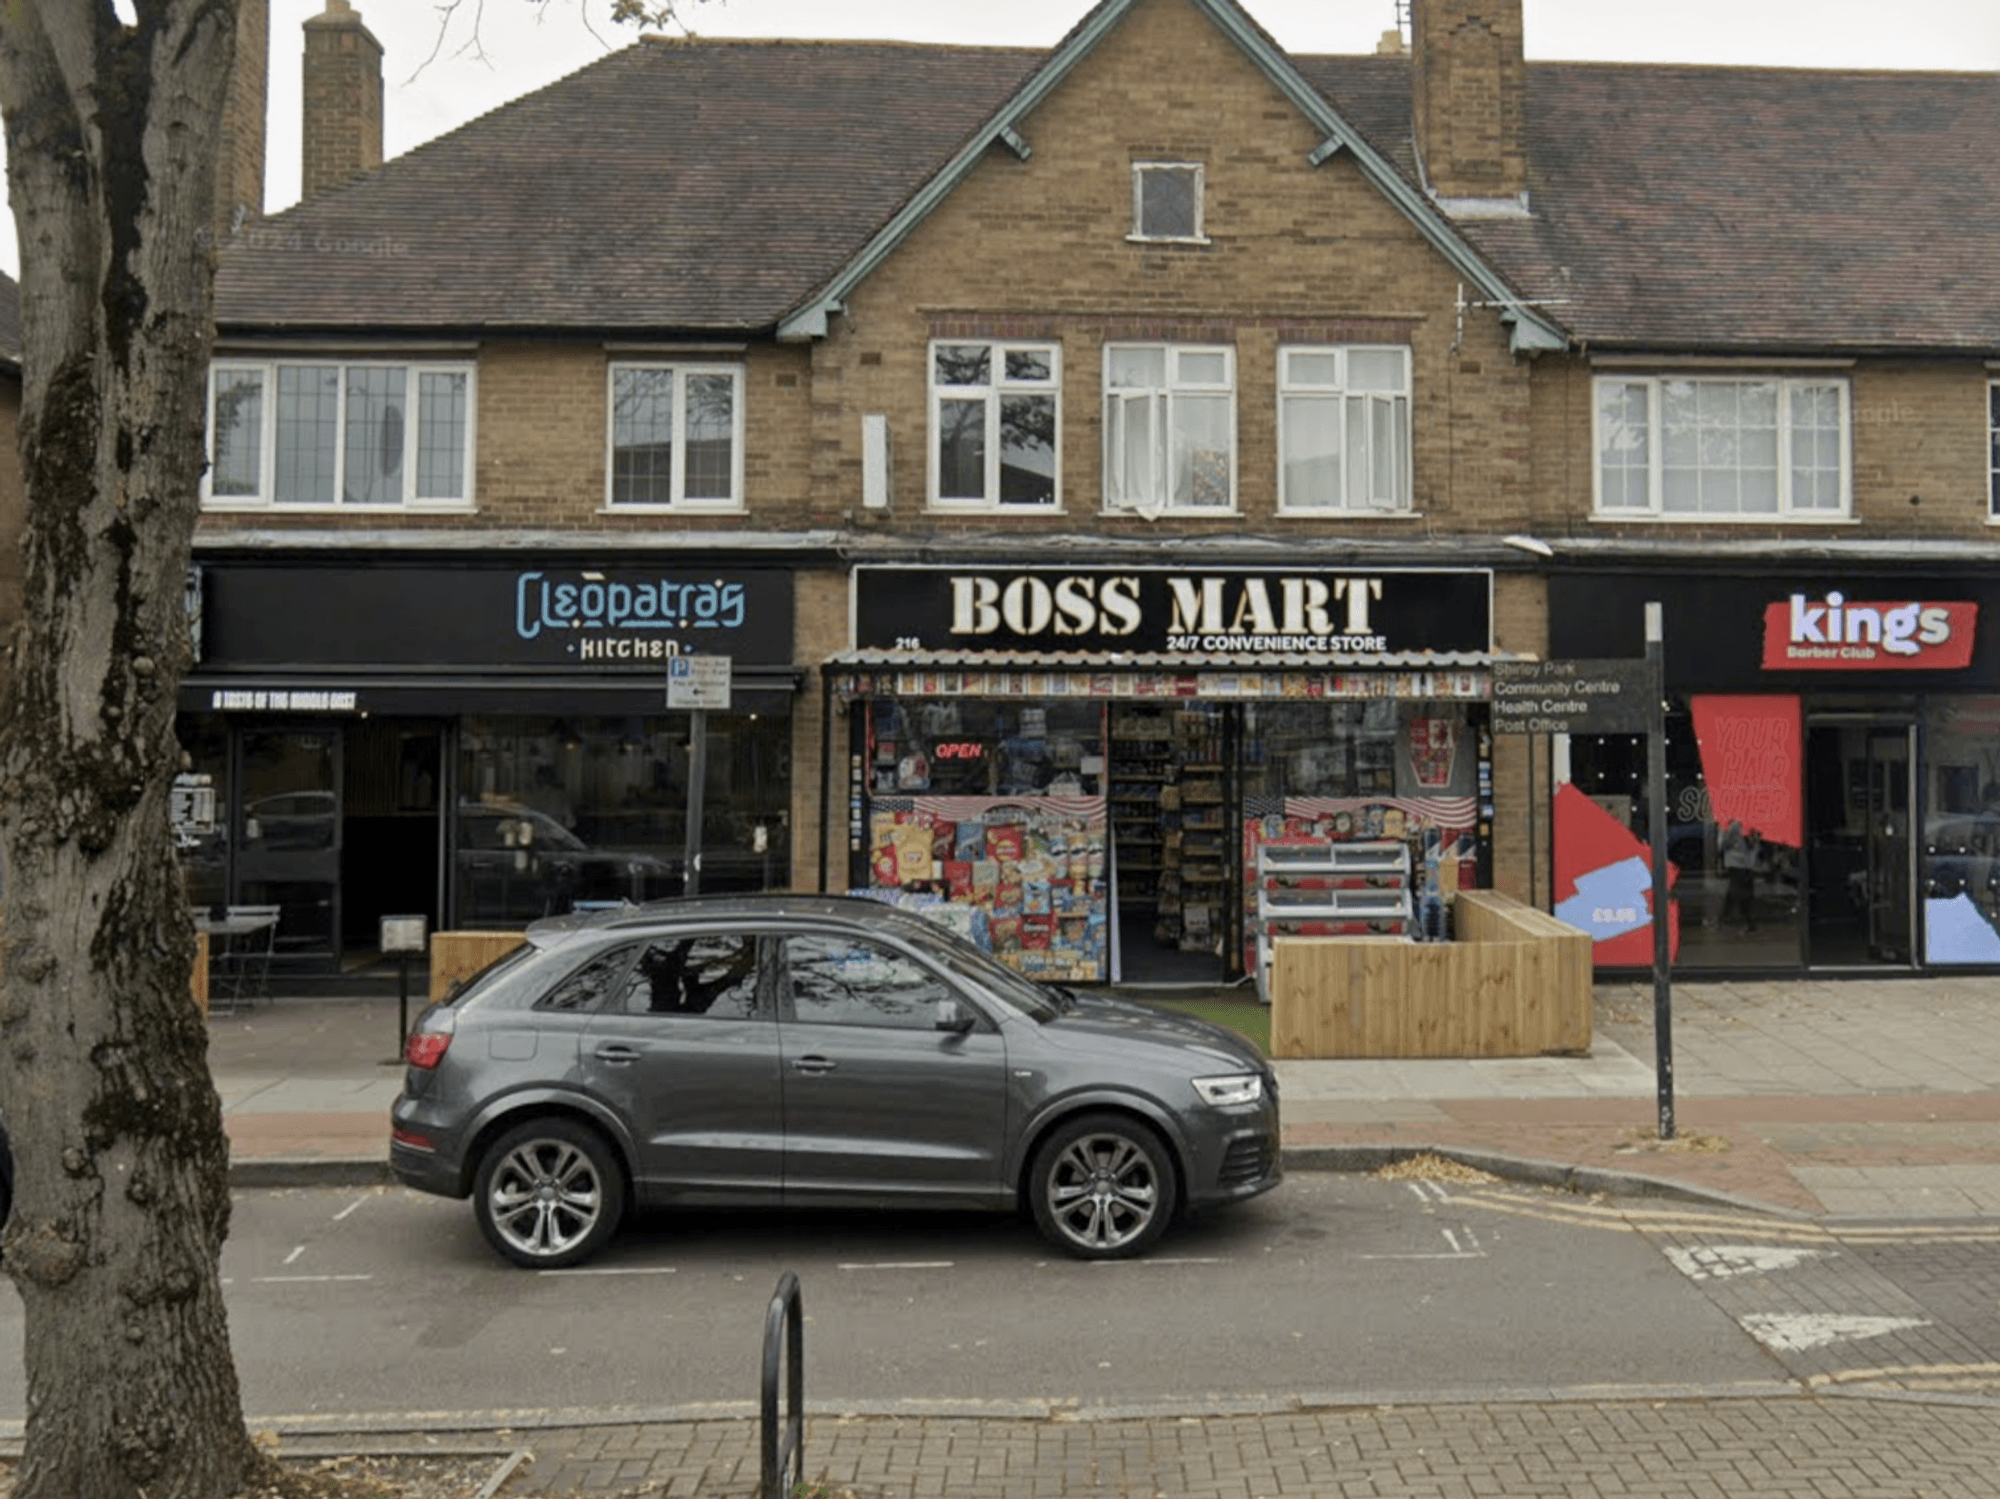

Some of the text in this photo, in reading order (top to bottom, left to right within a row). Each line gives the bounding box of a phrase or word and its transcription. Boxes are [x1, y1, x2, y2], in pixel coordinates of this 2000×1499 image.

[949, 576, 1383, 635] BOSS MART
[1789, 590, 1951, 656] kings
[1166, 636, 1388, 651] 24/7 CONVENIENCE STORE
[1786, 646, 1877, 659] Barber Club
[1494, 662, 1576, 678] Shirley Park
[1494, 680, 1620, 696] Community Centre
[1494, 700, 1588, 714] Health Centre
[1494, 718, 1569, 732] Post Office
[1714, 716, 1790, 752] YOUR
[935, 743, 983, 759] OPEN
